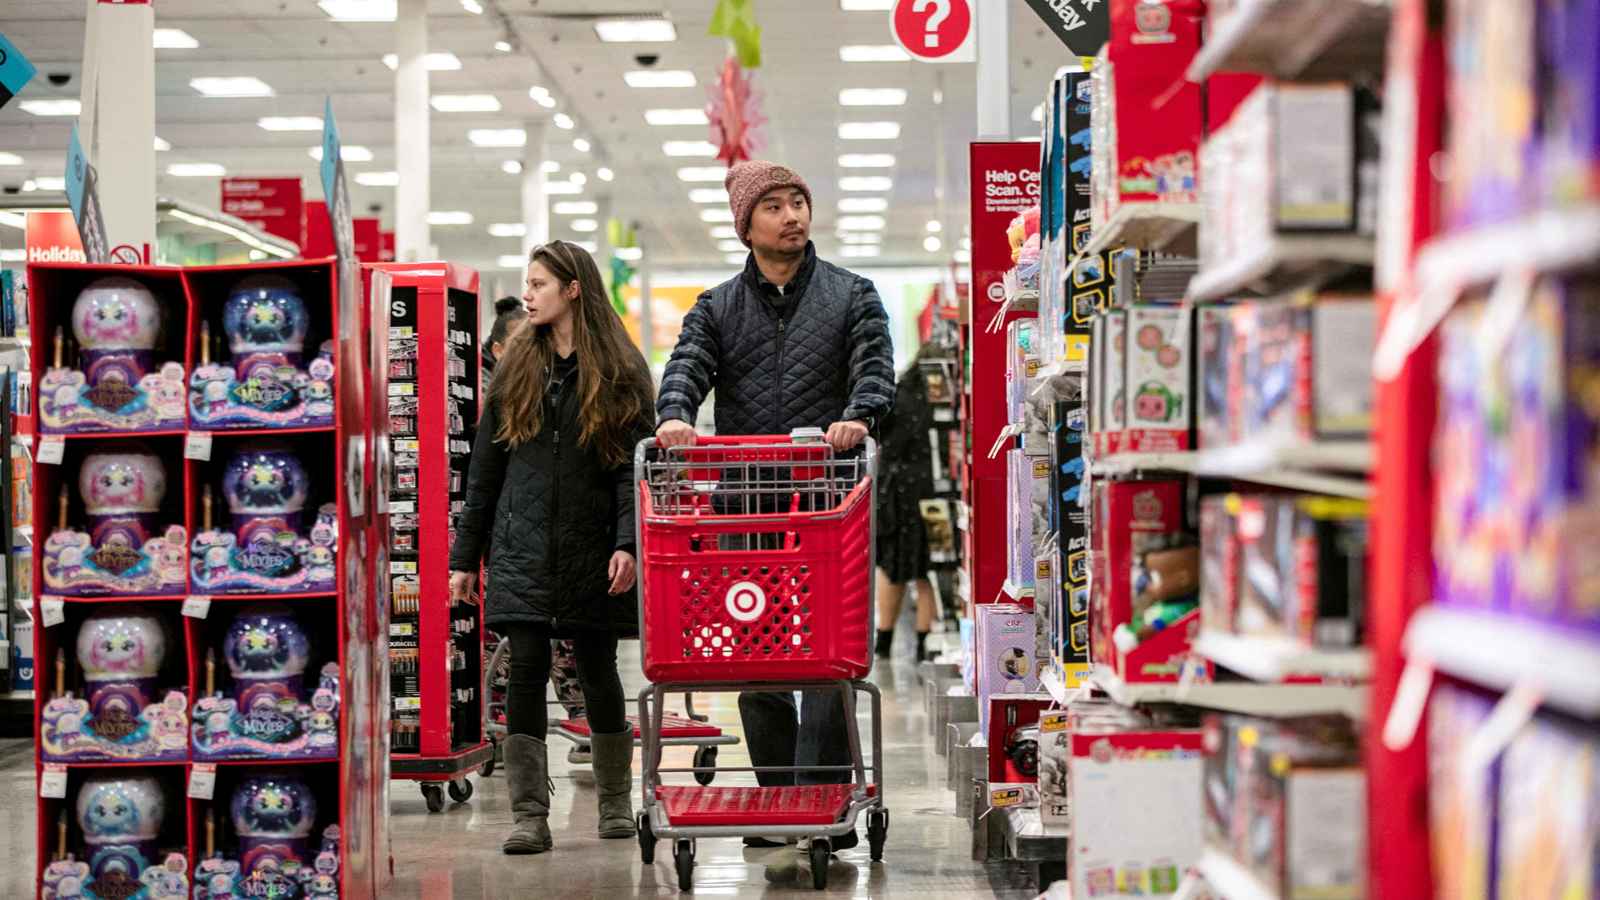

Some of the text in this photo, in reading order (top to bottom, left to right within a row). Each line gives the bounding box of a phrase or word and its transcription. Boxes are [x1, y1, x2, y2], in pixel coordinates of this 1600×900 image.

[1046, 0, 1087, 31] day
[985, 169, 1017, 185] Help
[985, 183, 1023, 196] Scan.
